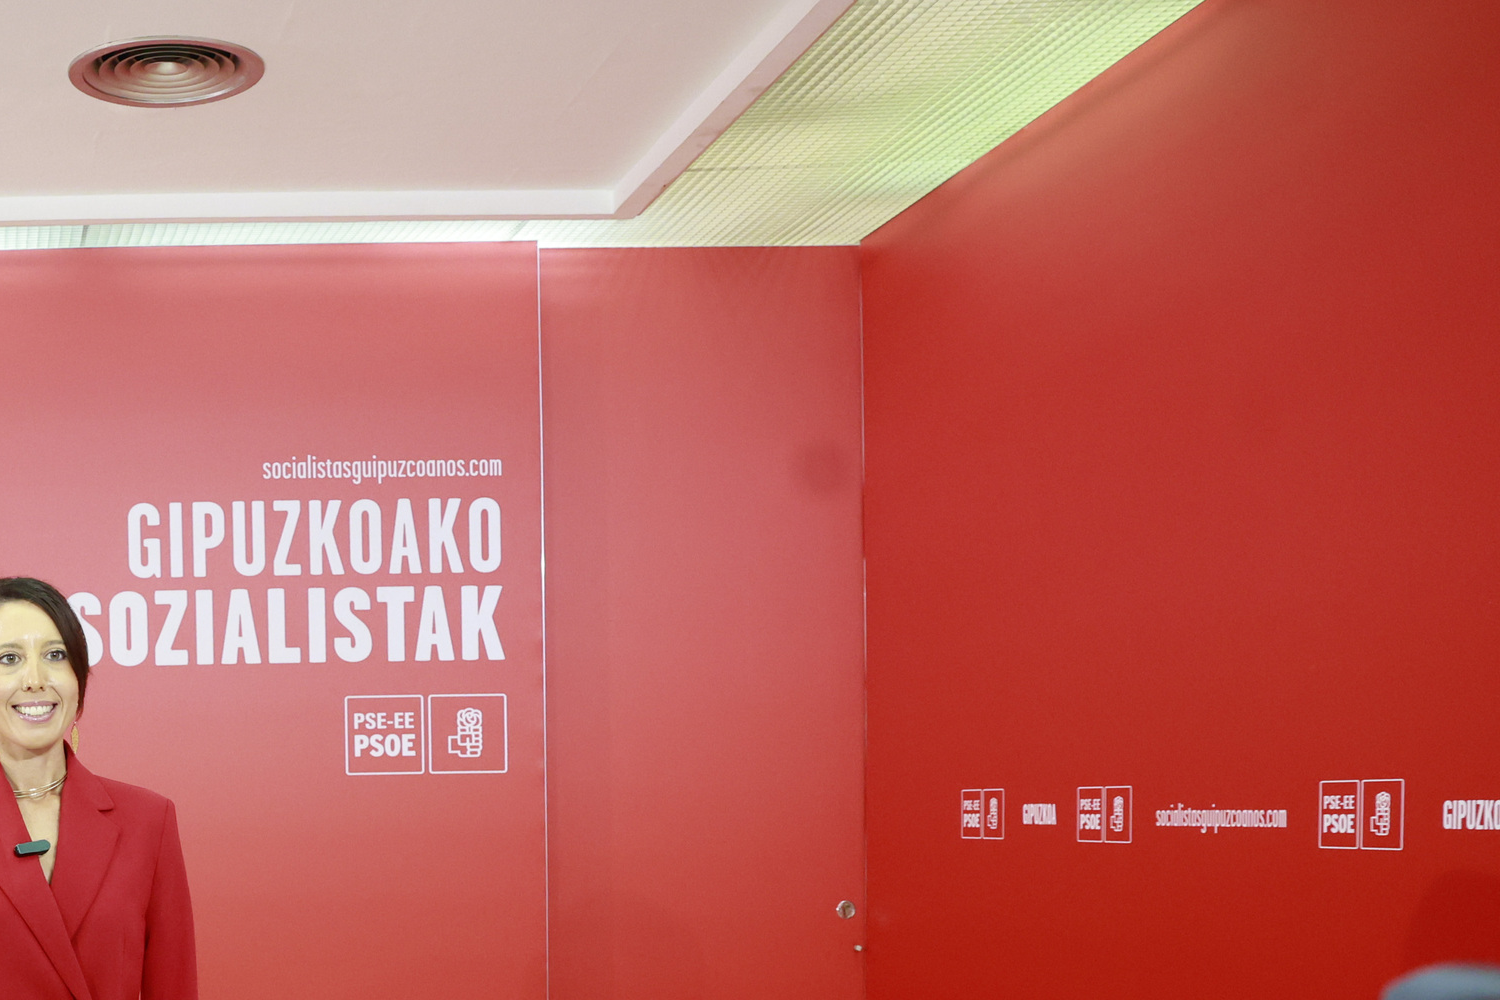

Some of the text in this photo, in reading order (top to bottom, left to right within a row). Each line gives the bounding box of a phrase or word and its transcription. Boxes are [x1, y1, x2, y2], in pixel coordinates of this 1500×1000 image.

[263, 455, 501, 484] socialistasguipuzcoanos.com
[128, 497, 501, 578] GIPUZKOAKO
[66, 585, 505, 667] SOZIALISTAK
[354, 712, 414, 729] PSE-EE
[354, 734, 416, 757] PSOE
[1079, 799, 1101, 810] PSE-EE
[1324, 795, 1355, 809] PSE-EE
[1023, 804, 1056, 825] GIPUZKOA
[1080, 814, 1101, 829] PSOE
[1156, 803, 1287, 833] socialistasguipuzcoanos.com
[1323, 814, 1355, 833] PSOE
